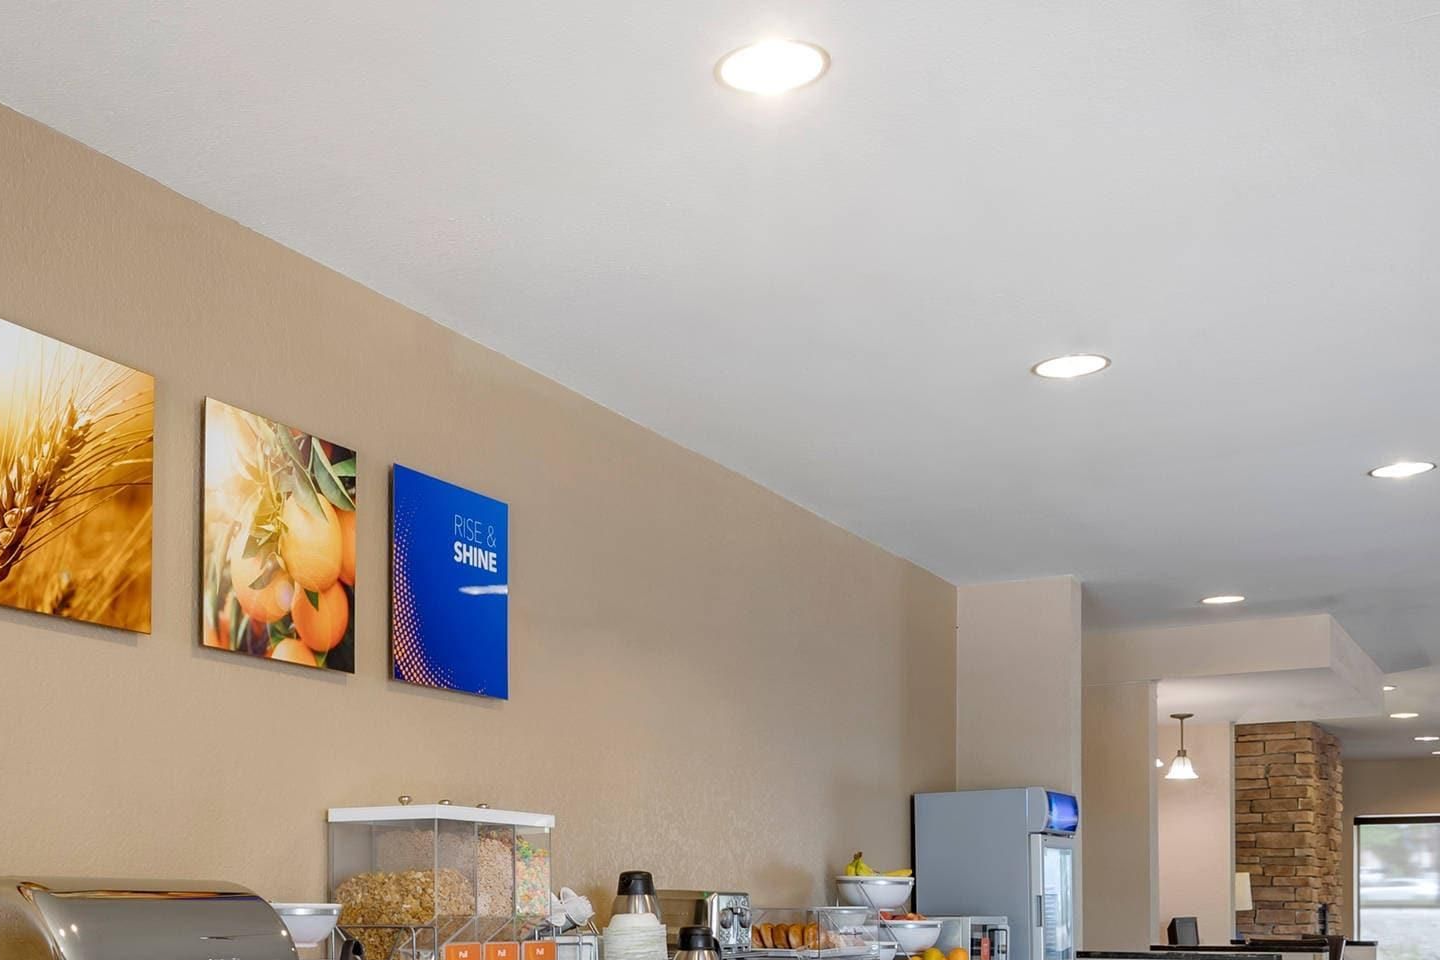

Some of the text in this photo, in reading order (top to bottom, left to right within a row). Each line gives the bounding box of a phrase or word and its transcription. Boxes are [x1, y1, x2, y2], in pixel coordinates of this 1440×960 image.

[454, 514, 497, 548] RISE &
[453, 540, 498, 573] SHINE
